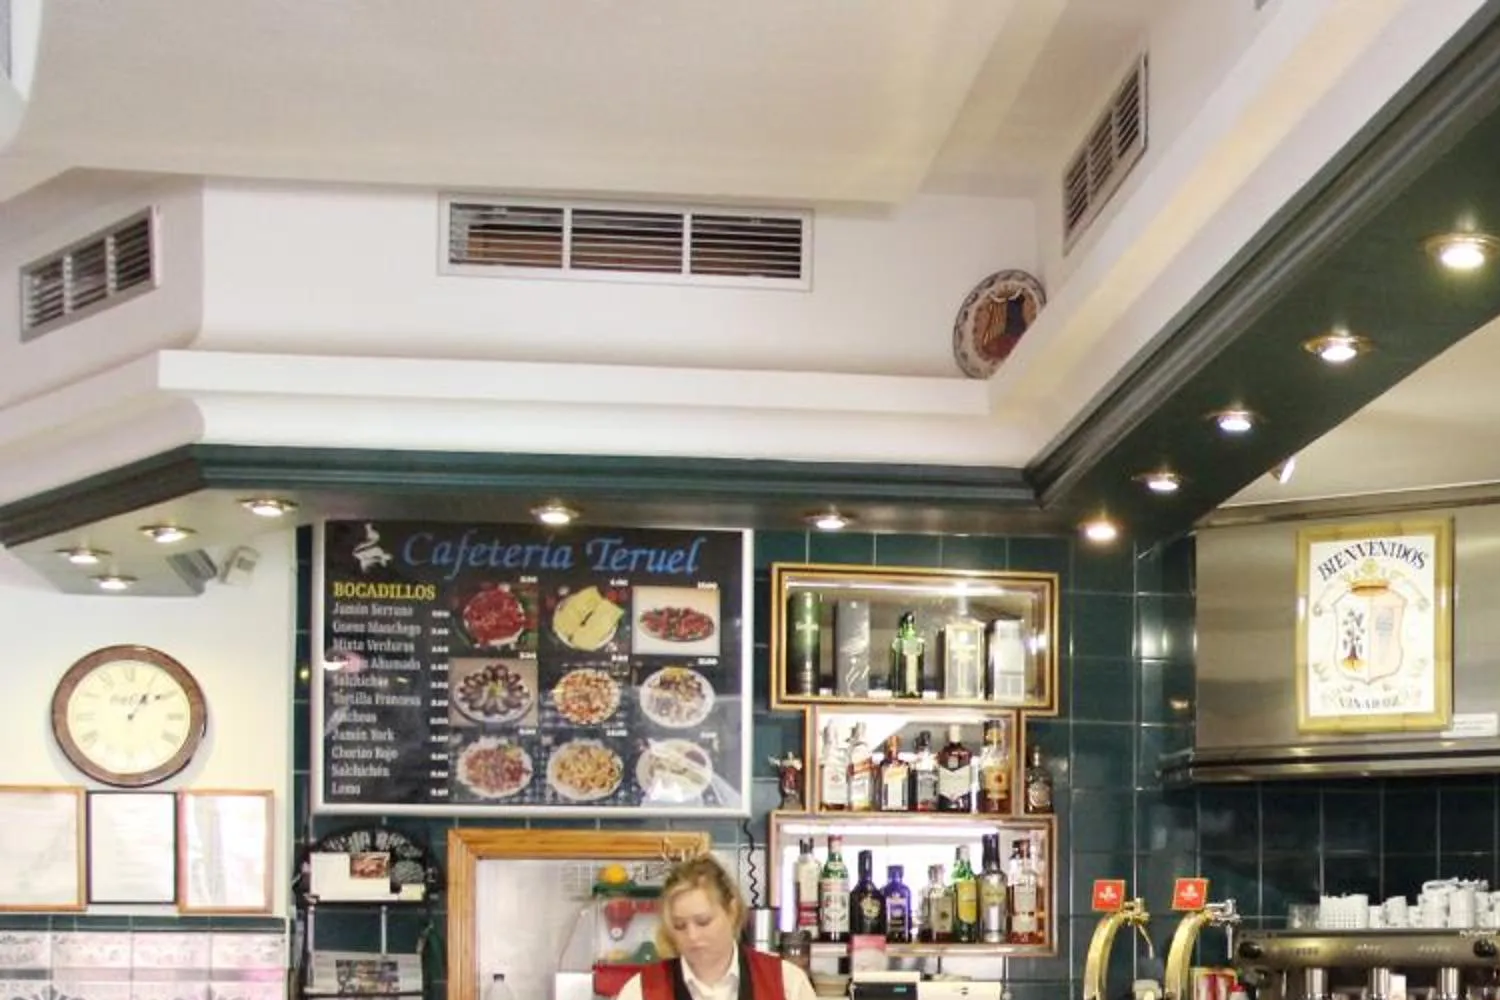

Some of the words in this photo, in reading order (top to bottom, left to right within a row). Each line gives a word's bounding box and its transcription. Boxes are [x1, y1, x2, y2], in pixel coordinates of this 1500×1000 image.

[586, 537, 707, 576] Teruel
[1317, 540, 1425, 581] BIENVENIDOS
[334, 582, 436, 600] BOCADILLOS
